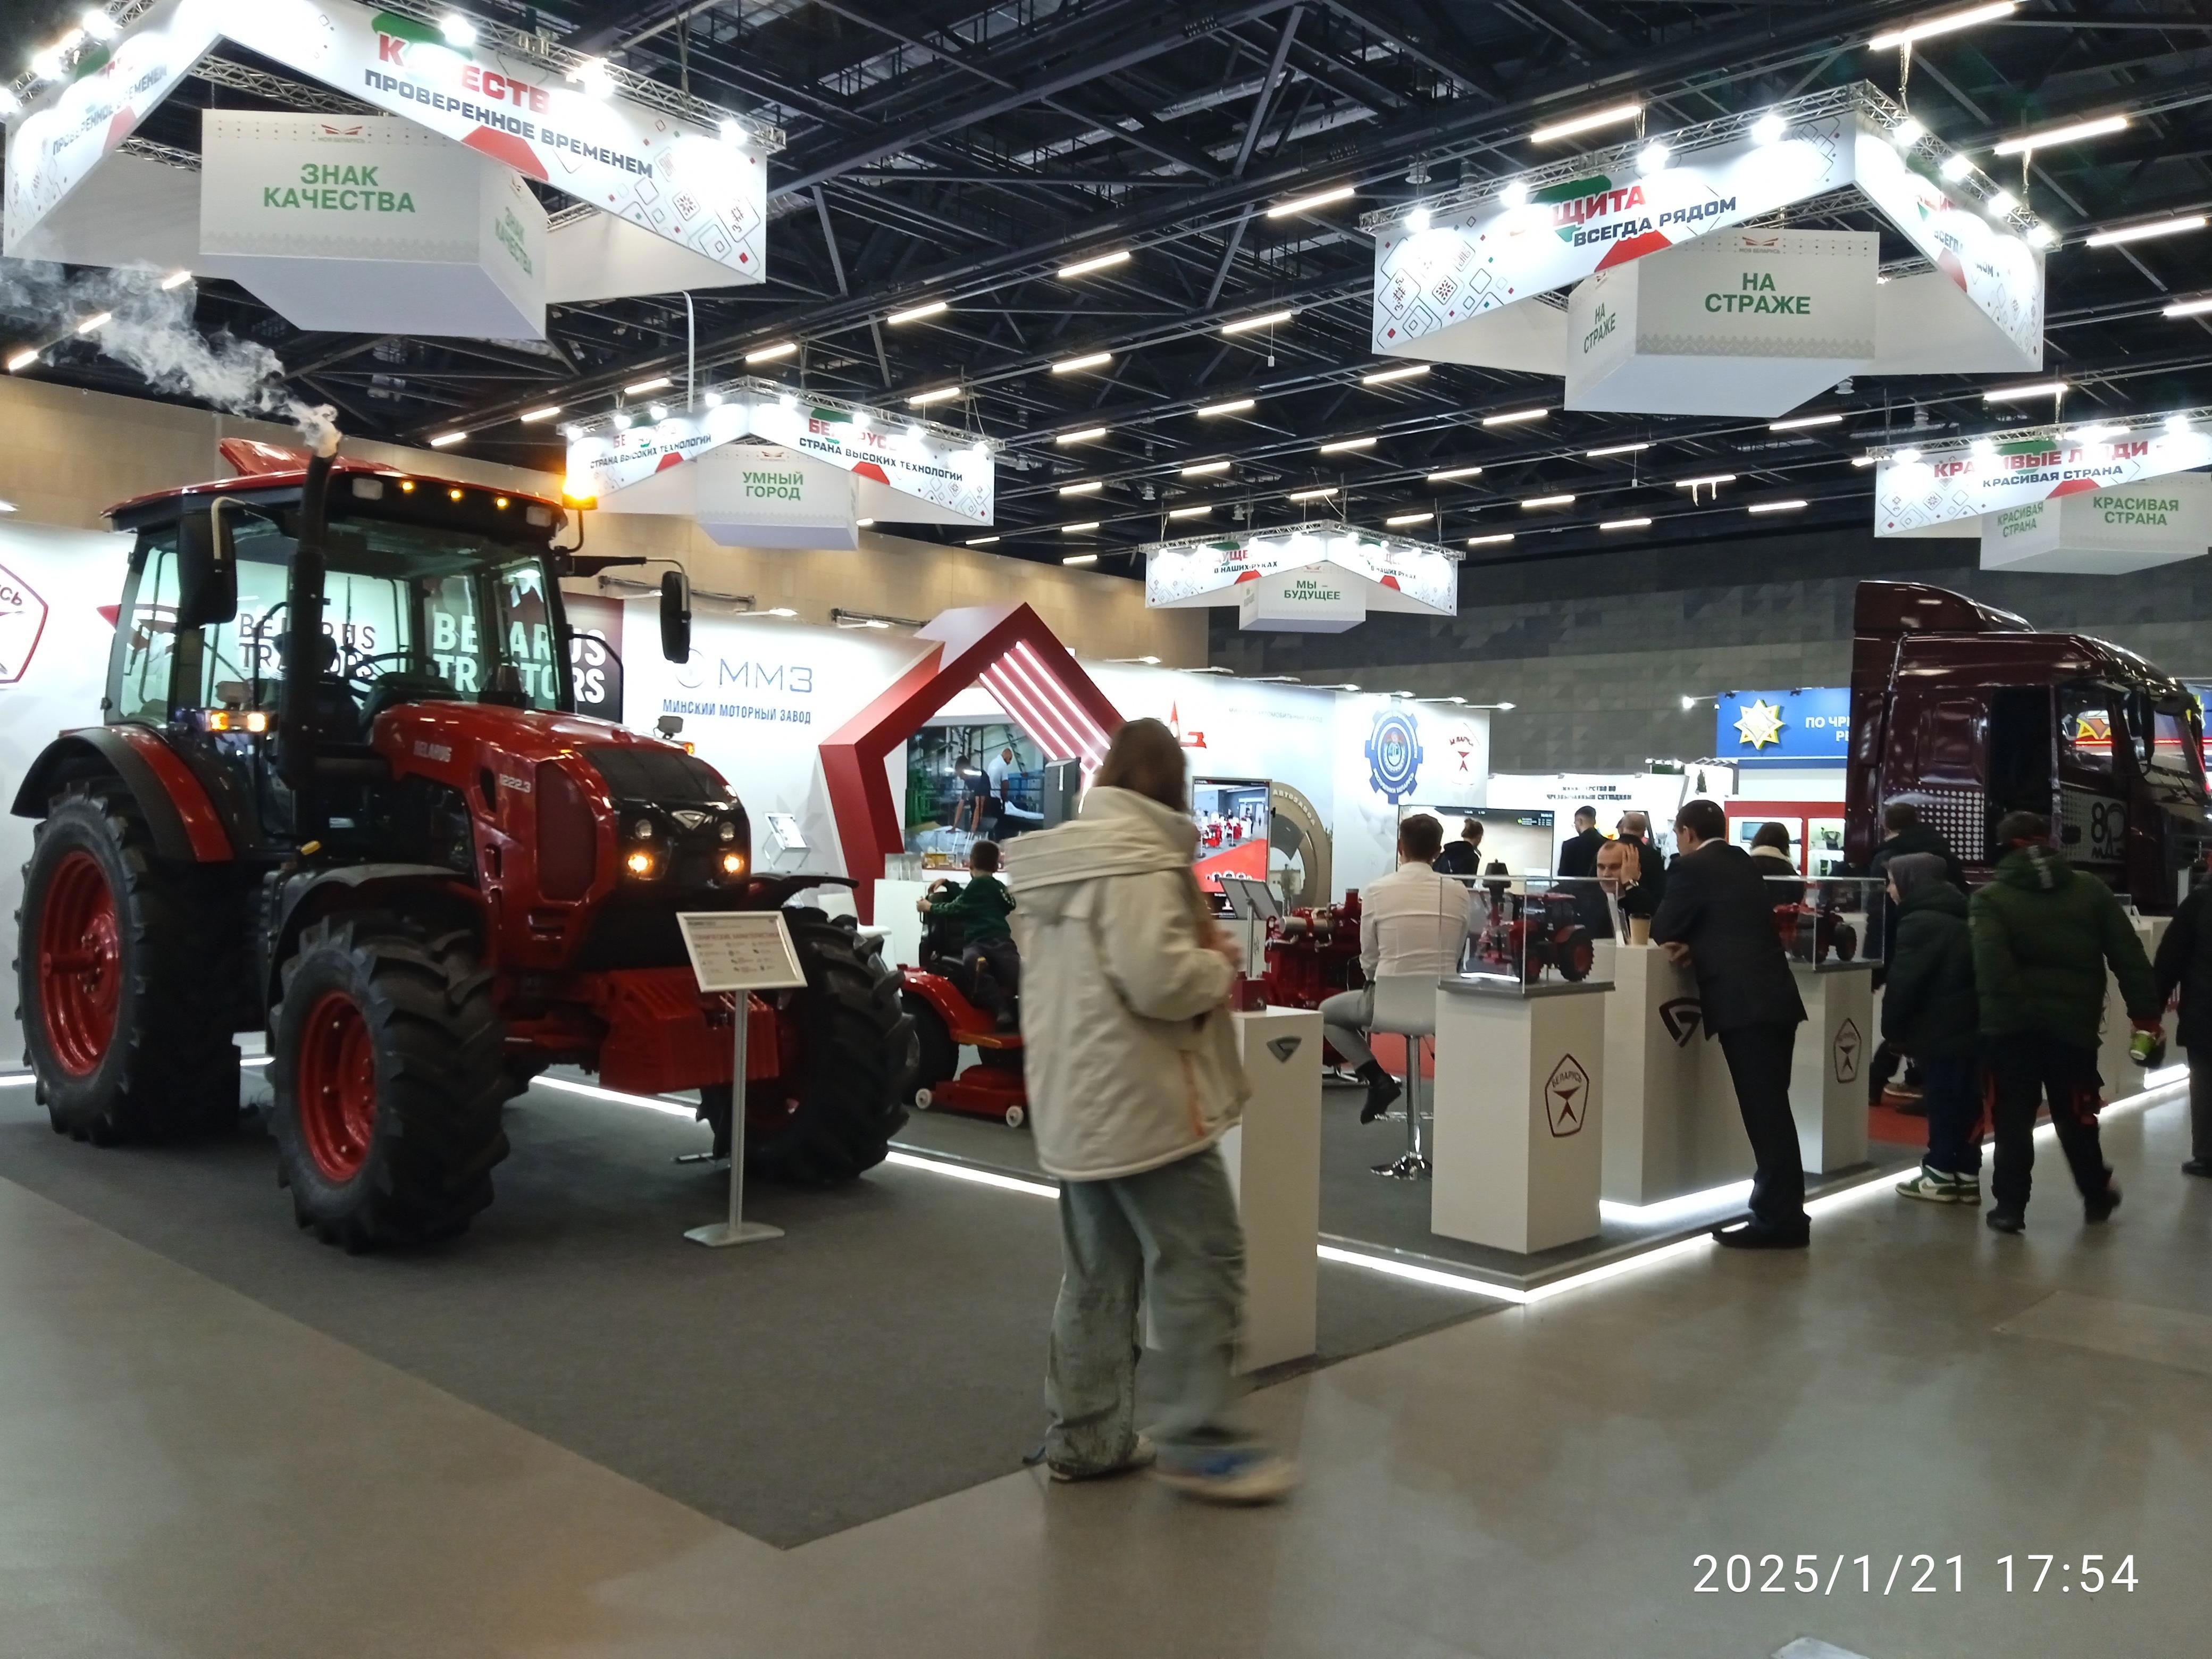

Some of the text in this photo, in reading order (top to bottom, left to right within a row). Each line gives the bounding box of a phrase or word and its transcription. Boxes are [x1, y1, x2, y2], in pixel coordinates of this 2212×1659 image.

[365, 69, 653, 178] ПРОВЕРЕННОЕ ВРЕМЕНЕМ
[300, 163, 379, 187] ЗНАК
[263, 187, 416, 213] КАЧЕСТВА
[1552, 186, 1646, 225] ЩИТА
[1574, 196, 1736, 247] ВСЕГДА РЯДОМ
[1742, 272, 1776, 291] НА
[1595, 302, 1606, 320] НА
[1705, 293, 1811, 315] СТРАЖЕ
[1583, 313, 1616, 354] СТРАЖЕ
[799, 437, 842, 455] СТРАНА
[845, 448, 896, 467] ВЫСОКИХ
[1933, 450, 2063, 479] КРАВЫЕ
[2068, 441, 2149, 464] ЛДИ
[742, 471, 803, 485] УМНЫЙ
[1982, 465, 2123, 488] КРАСИВАЯ СТРАНА
[746, 485, 801, 501] ГОРОД
[2092, 496, 2179, 512] КРАСИВАЯ
[1997, 501, 2044, 526] КРАСИВАЯ
[2104, 511, 2168, 526] СТРАНА
[2002, 517, 2038, 538] СТРАНА
[1221, 564, 1249, 573] НАШИХ
[1284, 590, 1341, 601] БУДУЩЕЕ
[1296, 580, 1317, 589] МЫ
[432, 611, 606, 666] BEARS
[432, 653, 605, 703] TRTORS
[719, 658, 812, 693] ММЗ
[780, 709, 811, 725] ЗАВОД
[1805, 716, 1825, 728] ПО
